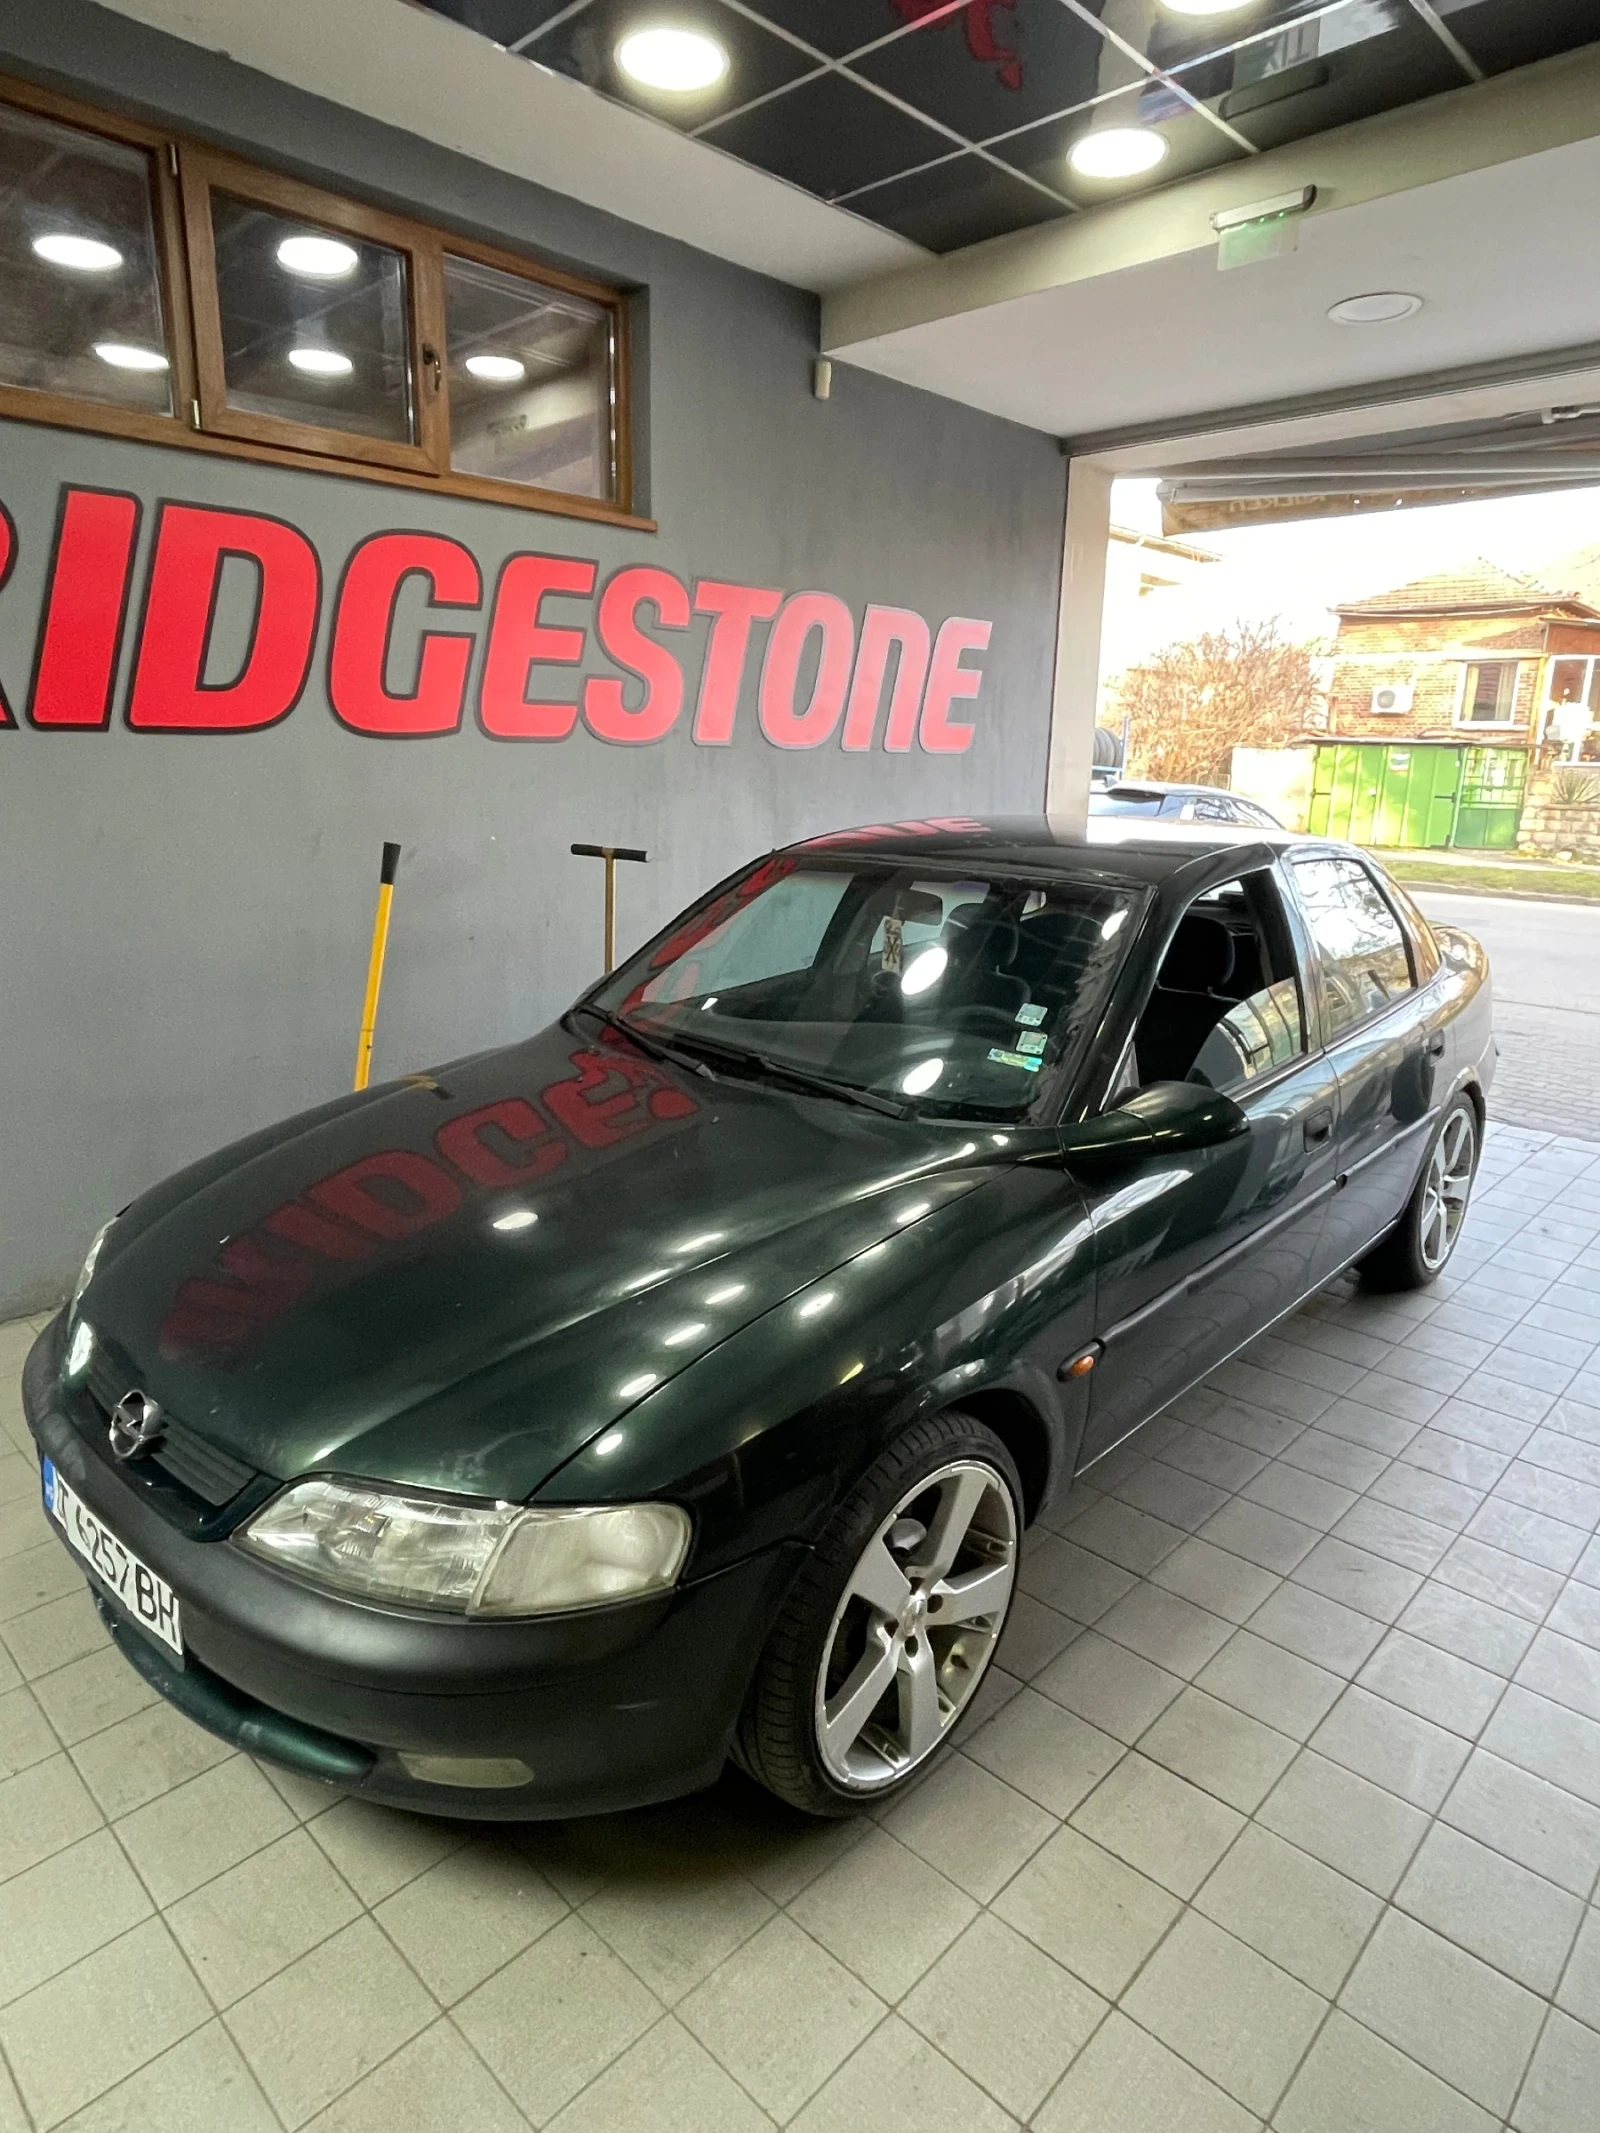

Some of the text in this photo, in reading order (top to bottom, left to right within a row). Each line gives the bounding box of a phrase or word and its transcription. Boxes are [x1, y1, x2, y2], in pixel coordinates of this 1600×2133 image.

[0, 481, 993, 753] IDGESTONE
[76, 1504, 129, 1593] 6257
[135, 1563, 177, 1643] BH
